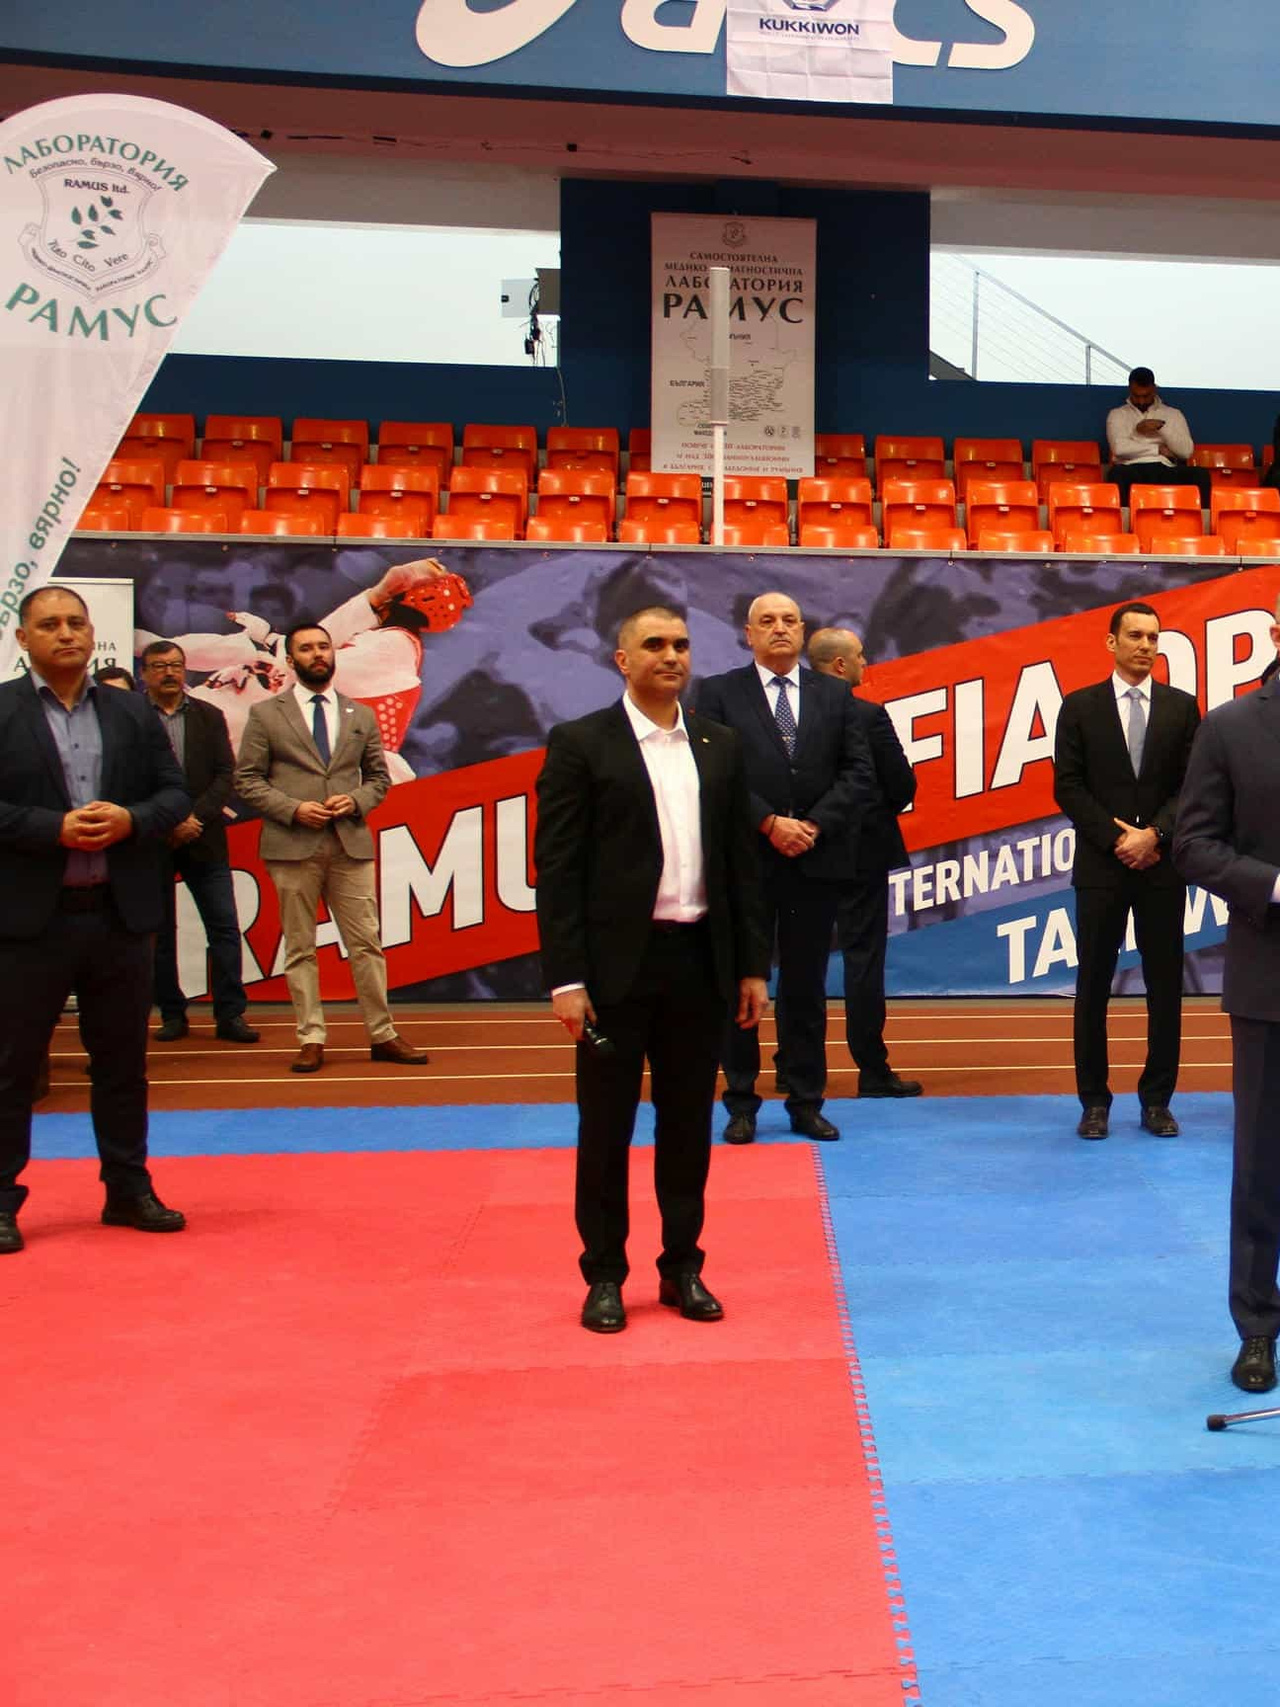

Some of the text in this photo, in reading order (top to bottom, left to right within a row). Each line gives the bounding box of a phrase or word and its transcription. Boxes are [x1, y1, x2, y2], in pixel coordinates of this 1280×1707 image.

[759, 18, 860, 35] KUKKIWON
[3, 134, 190, 192] ЛАБОРАТОРИЯ
[64, 178, 109, 192] RAMUS
[73, 254, 96, 273] Cito
[665, 275, 803, 293] ЛАБОАТОРИЯ
[5, 282, 178, 341] РАМУС
[29, 457, 82, 550] вярно!
